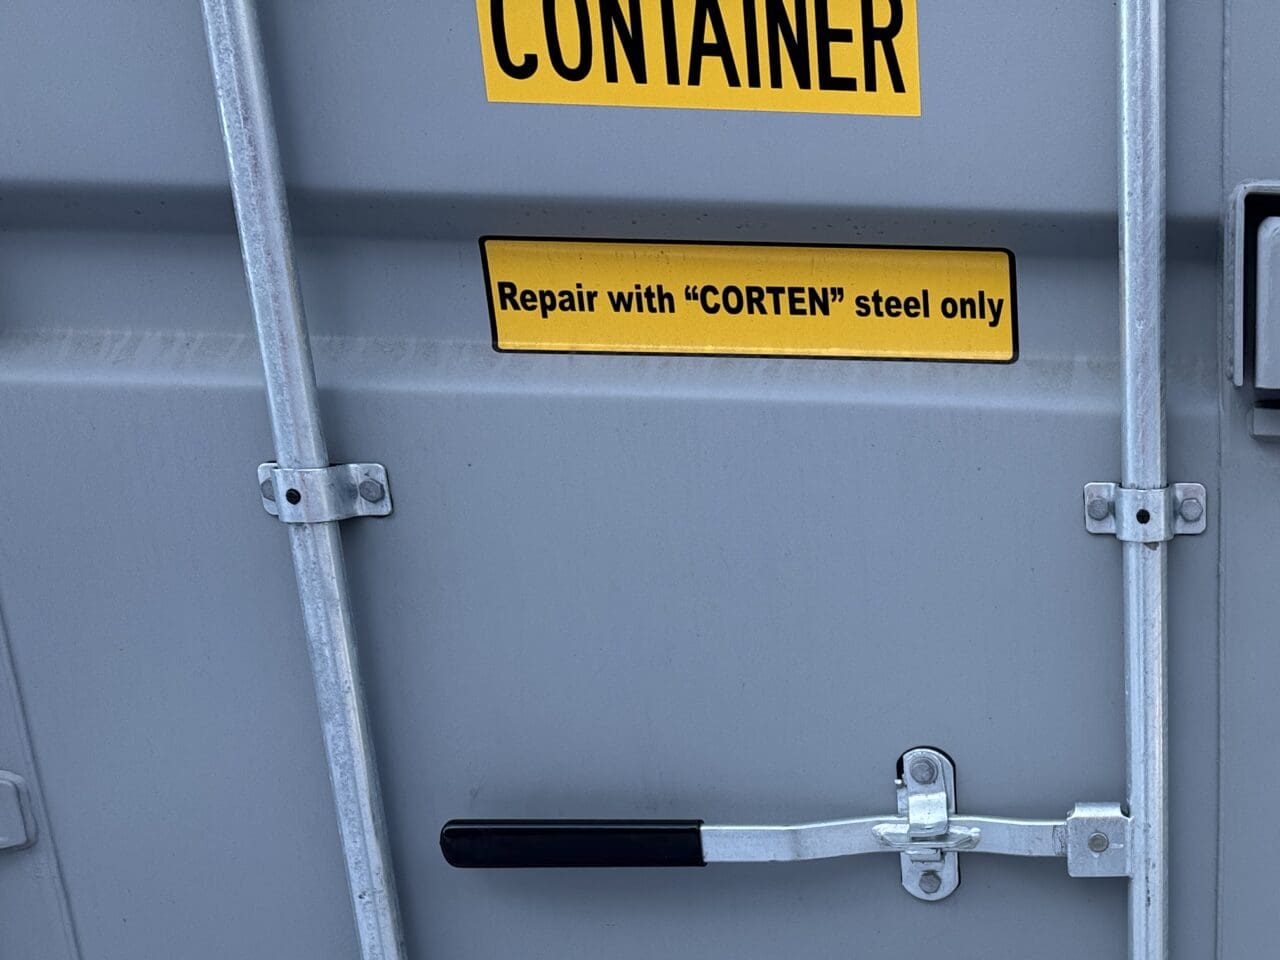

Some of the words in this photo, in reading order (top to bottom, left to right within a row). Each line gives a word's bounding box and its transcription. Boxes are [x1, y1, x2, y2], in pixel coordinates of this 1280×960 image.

[489, 0, 908, 94] CONTAINER
[496, 281, 598, 319] Repair
[607, 283, 676, 314] with
[855, 289, 930, 318] steel
[940, 290, 1004, 327] only
